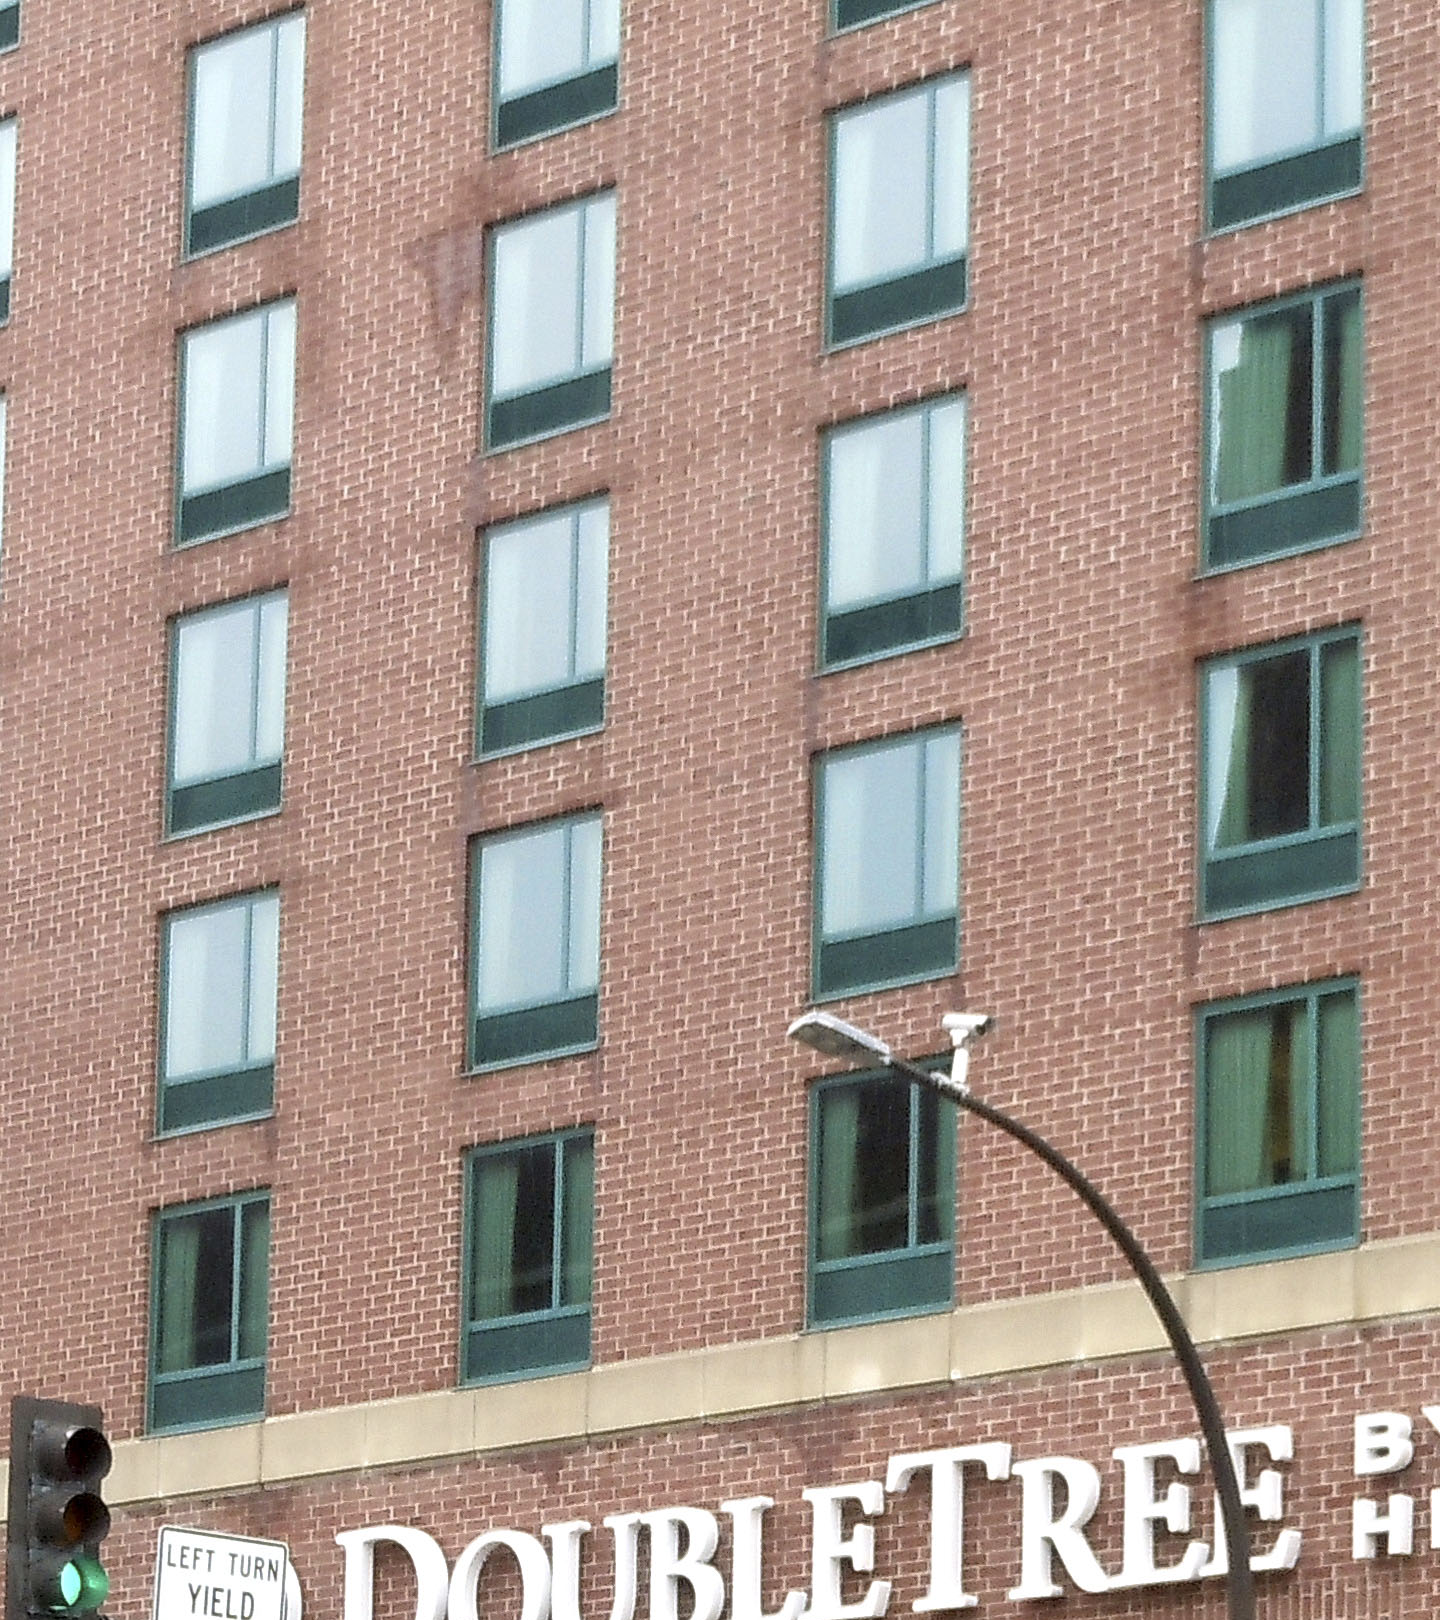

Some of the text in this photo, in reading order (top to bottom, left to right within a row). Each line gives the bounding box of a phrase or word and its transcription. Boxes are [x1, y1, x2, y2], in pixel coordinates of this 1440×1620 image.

[167, 1544, 279, 1582] LEFT TURN
[188, 1583, 254, 1620] YIELD
